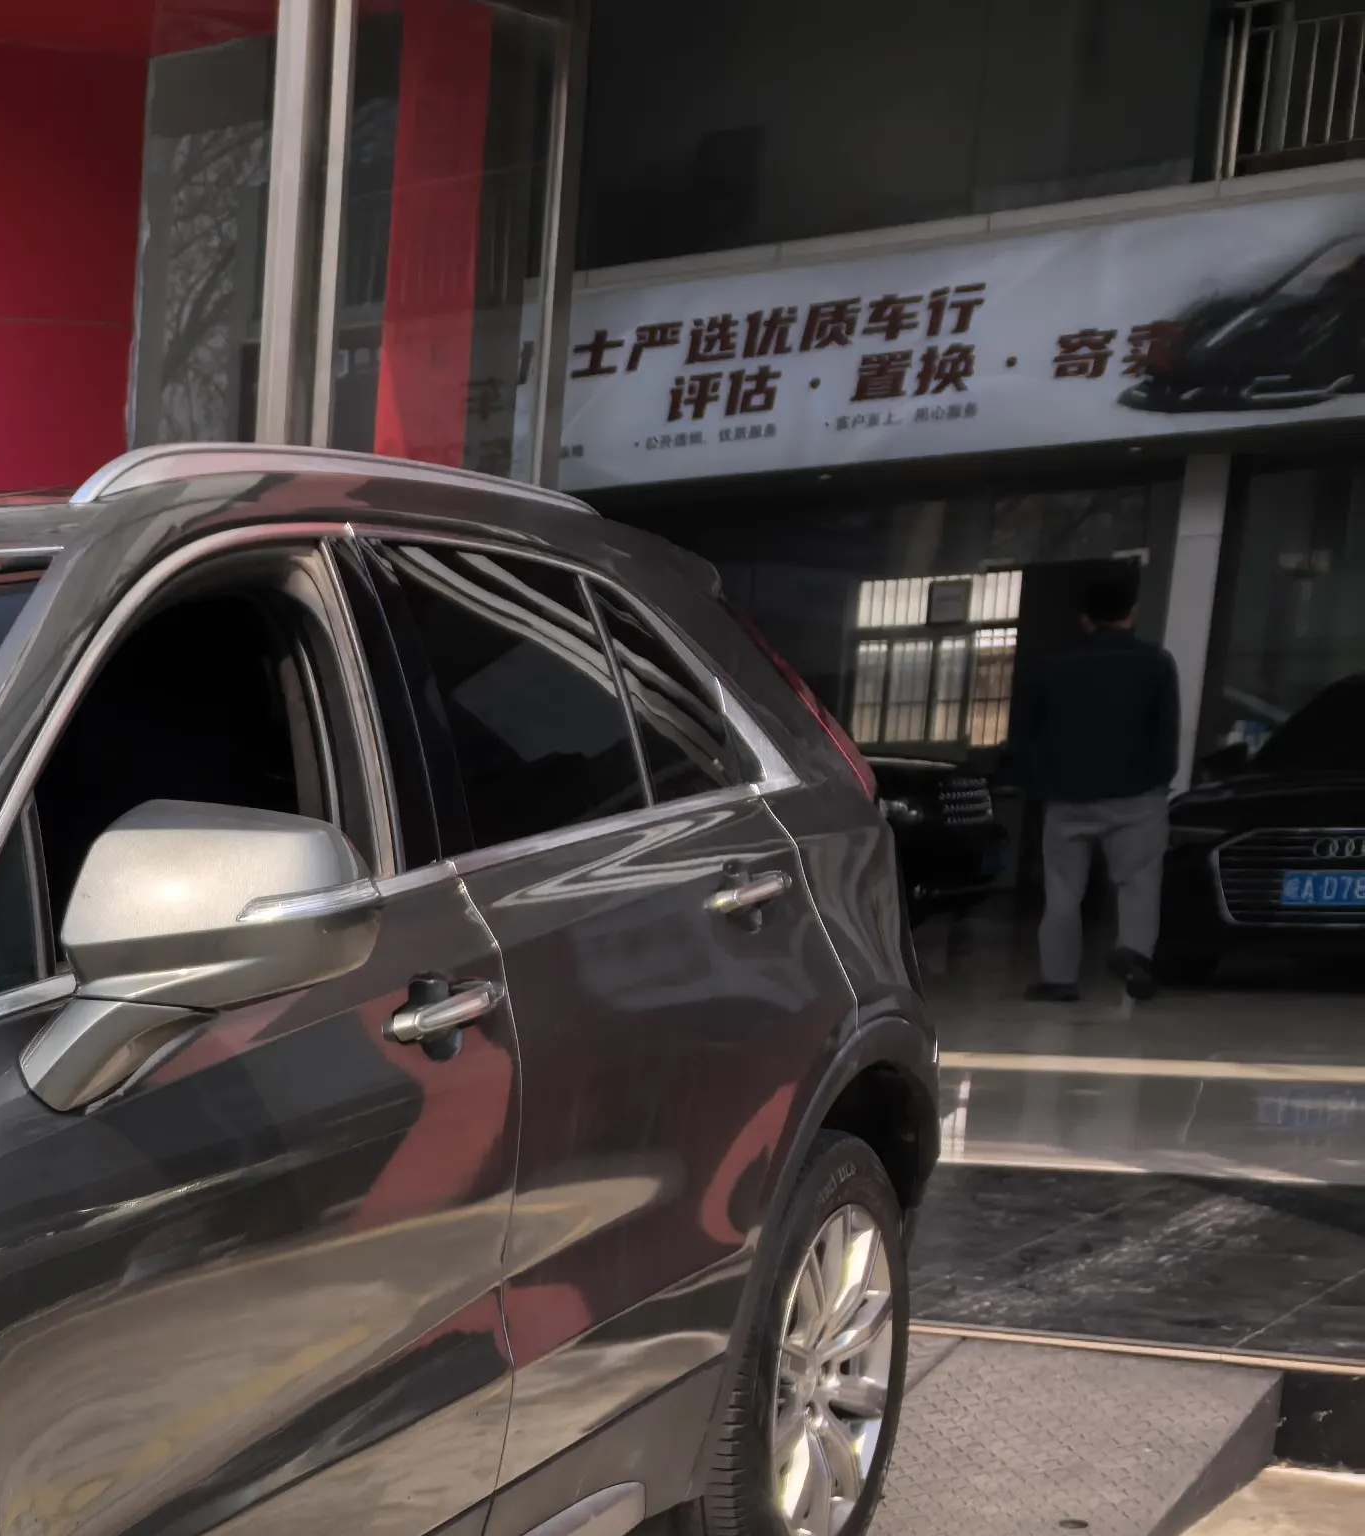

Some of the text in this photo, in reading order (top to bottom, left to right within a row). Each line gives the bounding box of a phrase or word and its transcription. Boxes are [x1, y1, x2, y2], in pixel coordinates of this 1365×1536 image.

[571, 282, 987, 378] 士严选优质车行
